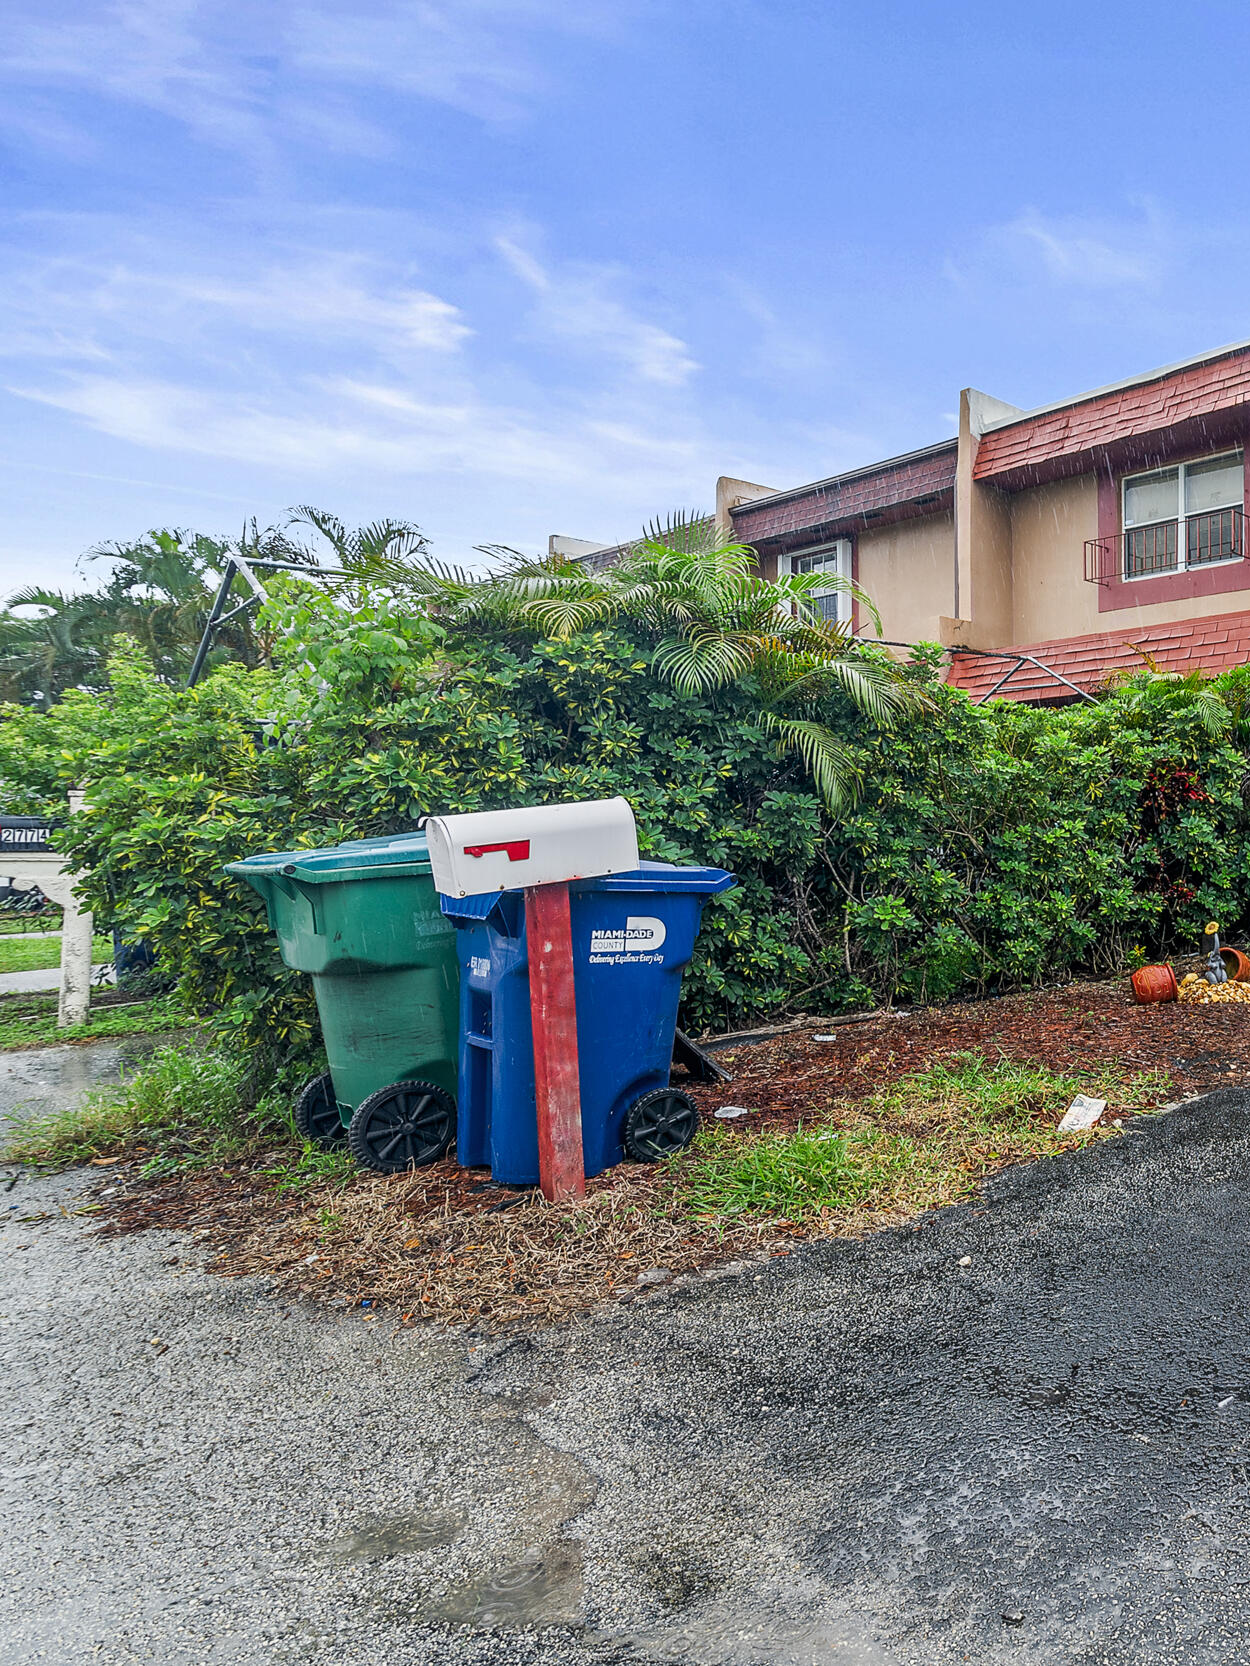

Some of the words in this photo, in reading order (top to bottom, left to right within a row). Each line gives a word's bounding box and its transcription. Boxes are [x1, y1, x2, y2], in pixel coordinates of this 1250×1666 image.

[3, 829, 48, 842] 2774
[591, 929, 653, 939] MIAMI-DADE
[592, 941, 623, 950] COUNTY
